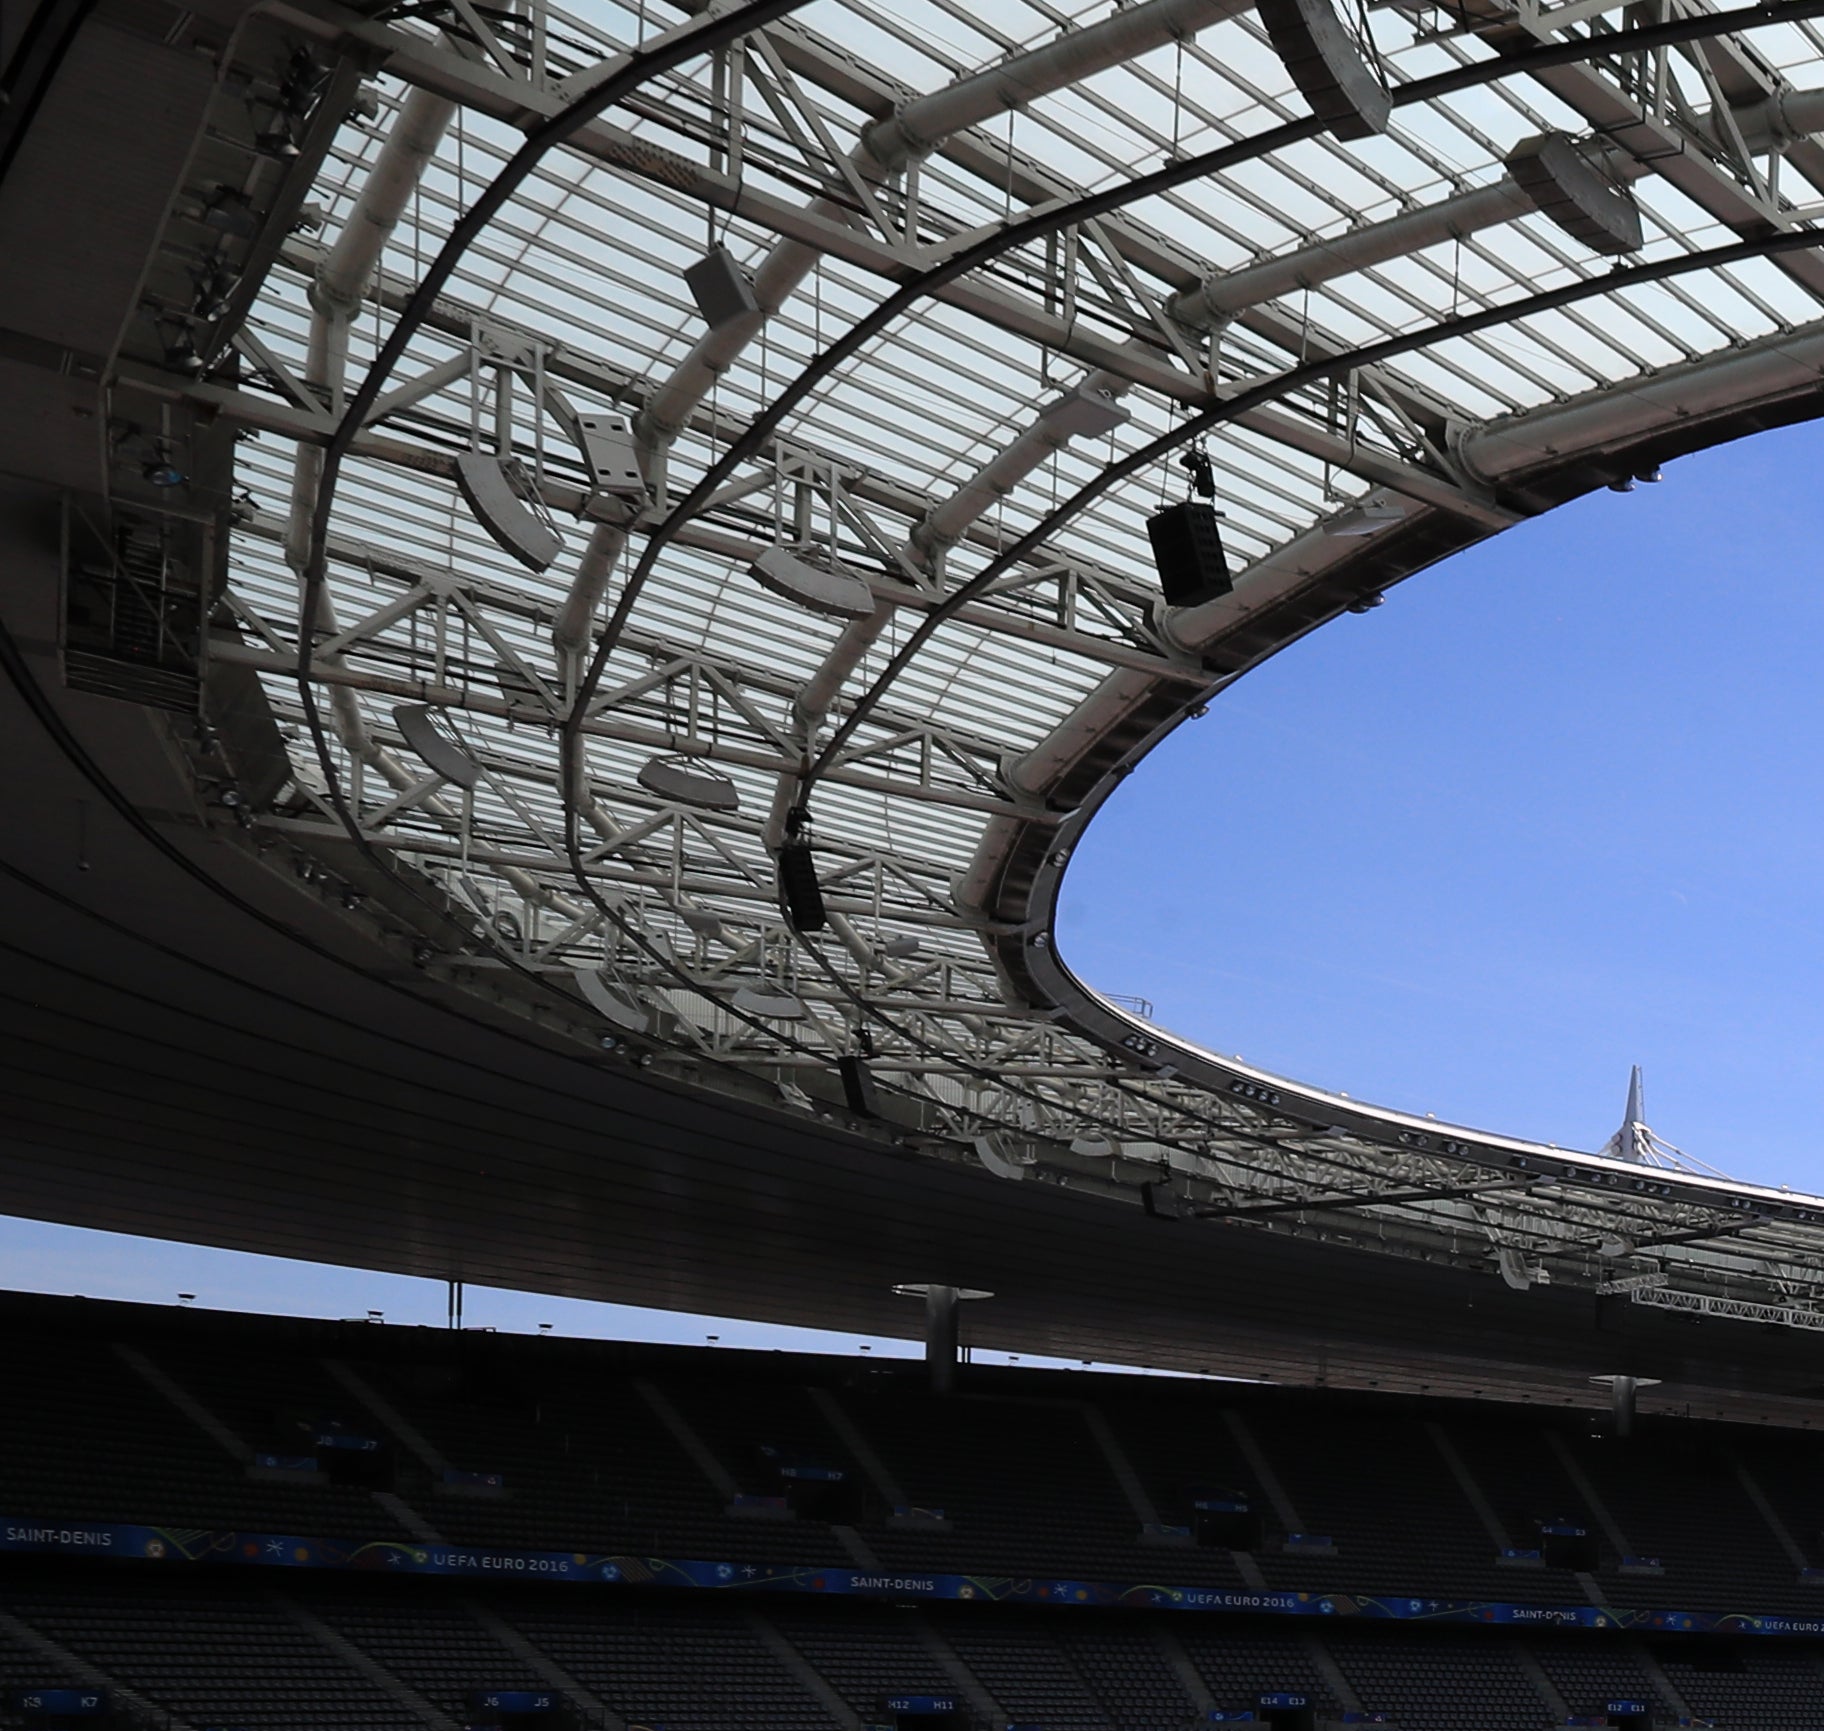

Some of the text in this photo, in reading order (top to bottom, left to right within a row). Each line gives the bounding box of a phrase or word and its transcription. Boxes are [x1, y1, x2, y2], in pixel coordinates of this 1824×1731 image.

[7, 1525, 112, 1547] SAINT-DENIS
[433, 1553, 569, 1572] UEFA EURO 2016
[850, 1575, 935, 1591] SAINT-DENIS
[1186, 1592, 1295, 1609] UEFA EURO 2016
[1791, 1622, 1819, 1631] EURO
[80, 1696, 98, 1708] K7
[484, 1697, 550, 1707] J6 J5
[888, 1700, 953, 1710] H12 H11
